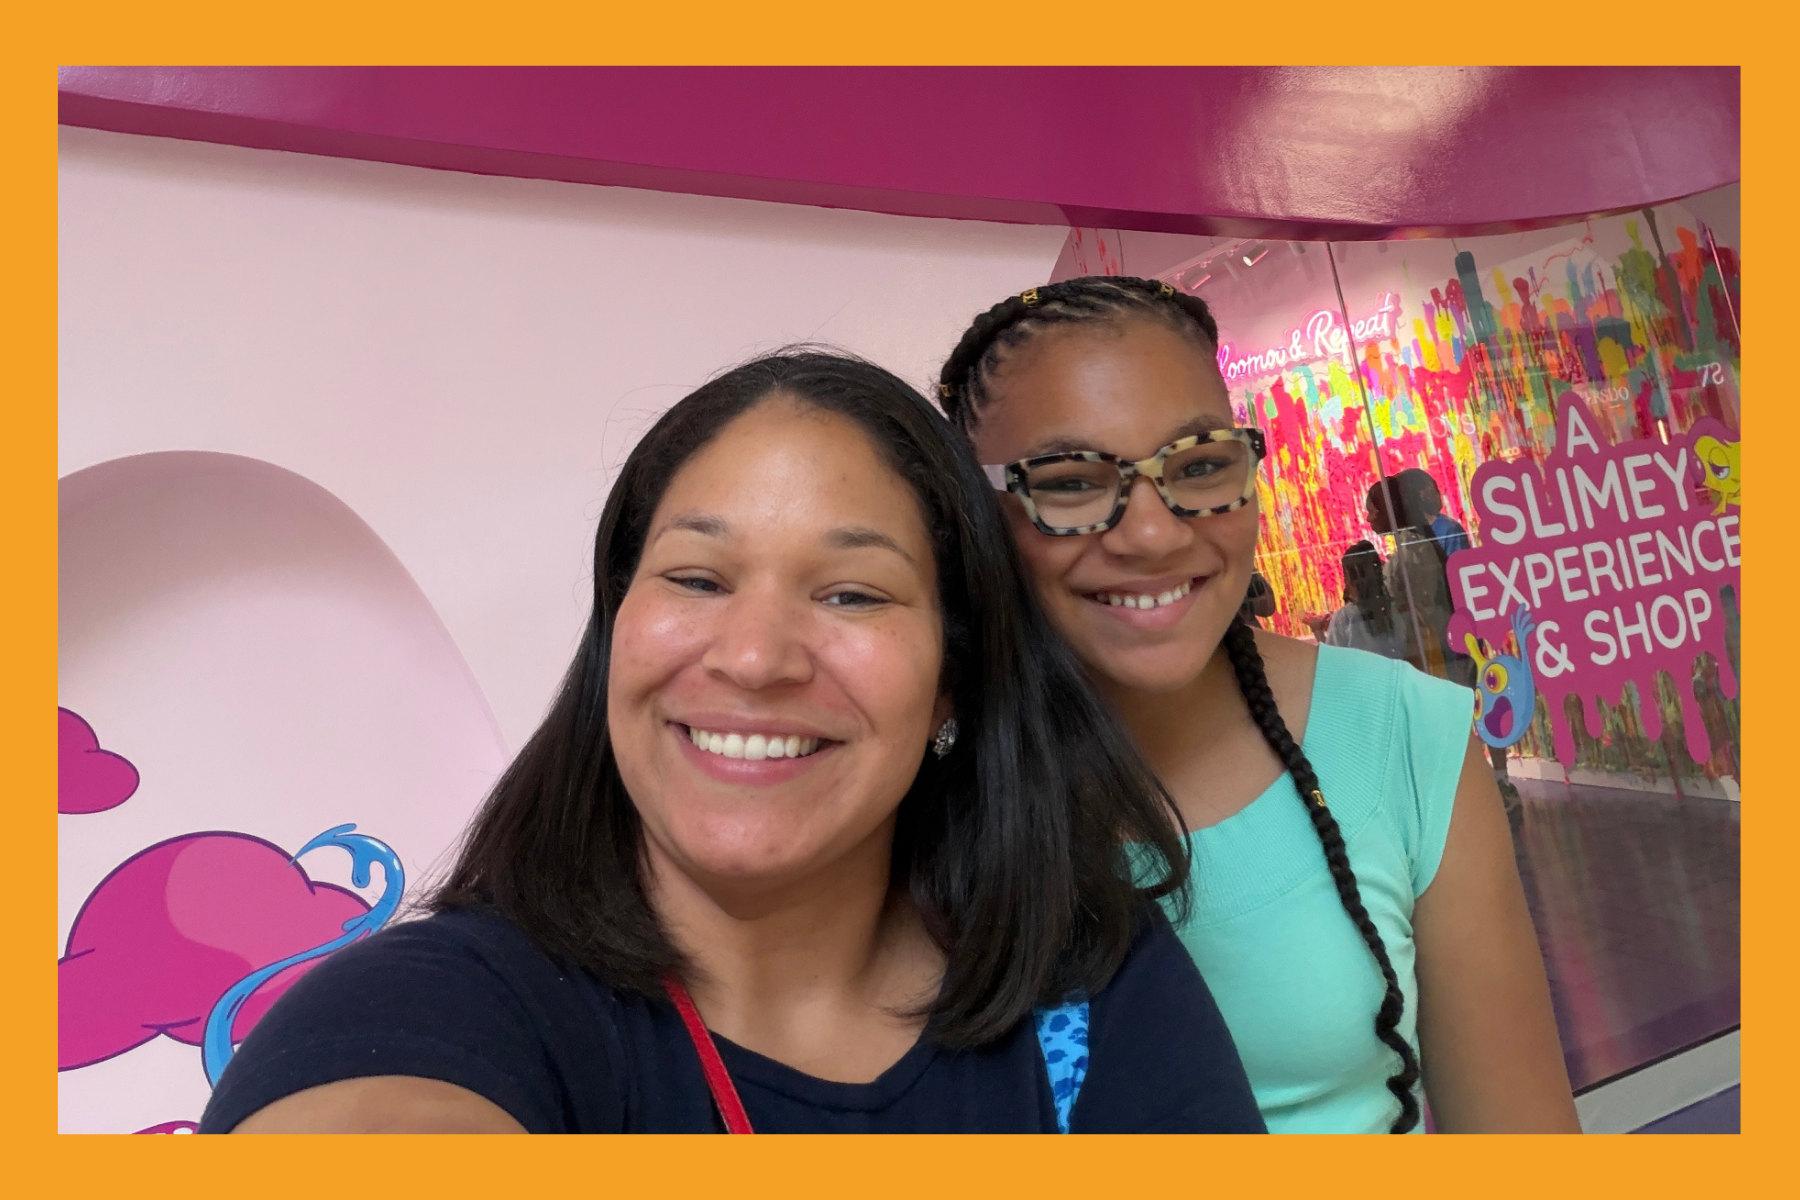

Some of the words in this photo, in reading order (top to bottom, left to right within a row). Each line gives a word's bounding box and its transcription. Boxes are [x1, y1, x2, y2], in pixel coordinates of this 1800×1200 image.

[1289, 328, 1307, 360] &
[1306, 292, 1394, 366] Repeat
[1567, 405, 1599, 458] A
[1482, 447, 1689, 545] SLIMEY
[1458, 515, 1741, 622] EXPERIENCE
[1535, 620, 1576, 678] &
[1583, 587, 1712, 666] SHOP
